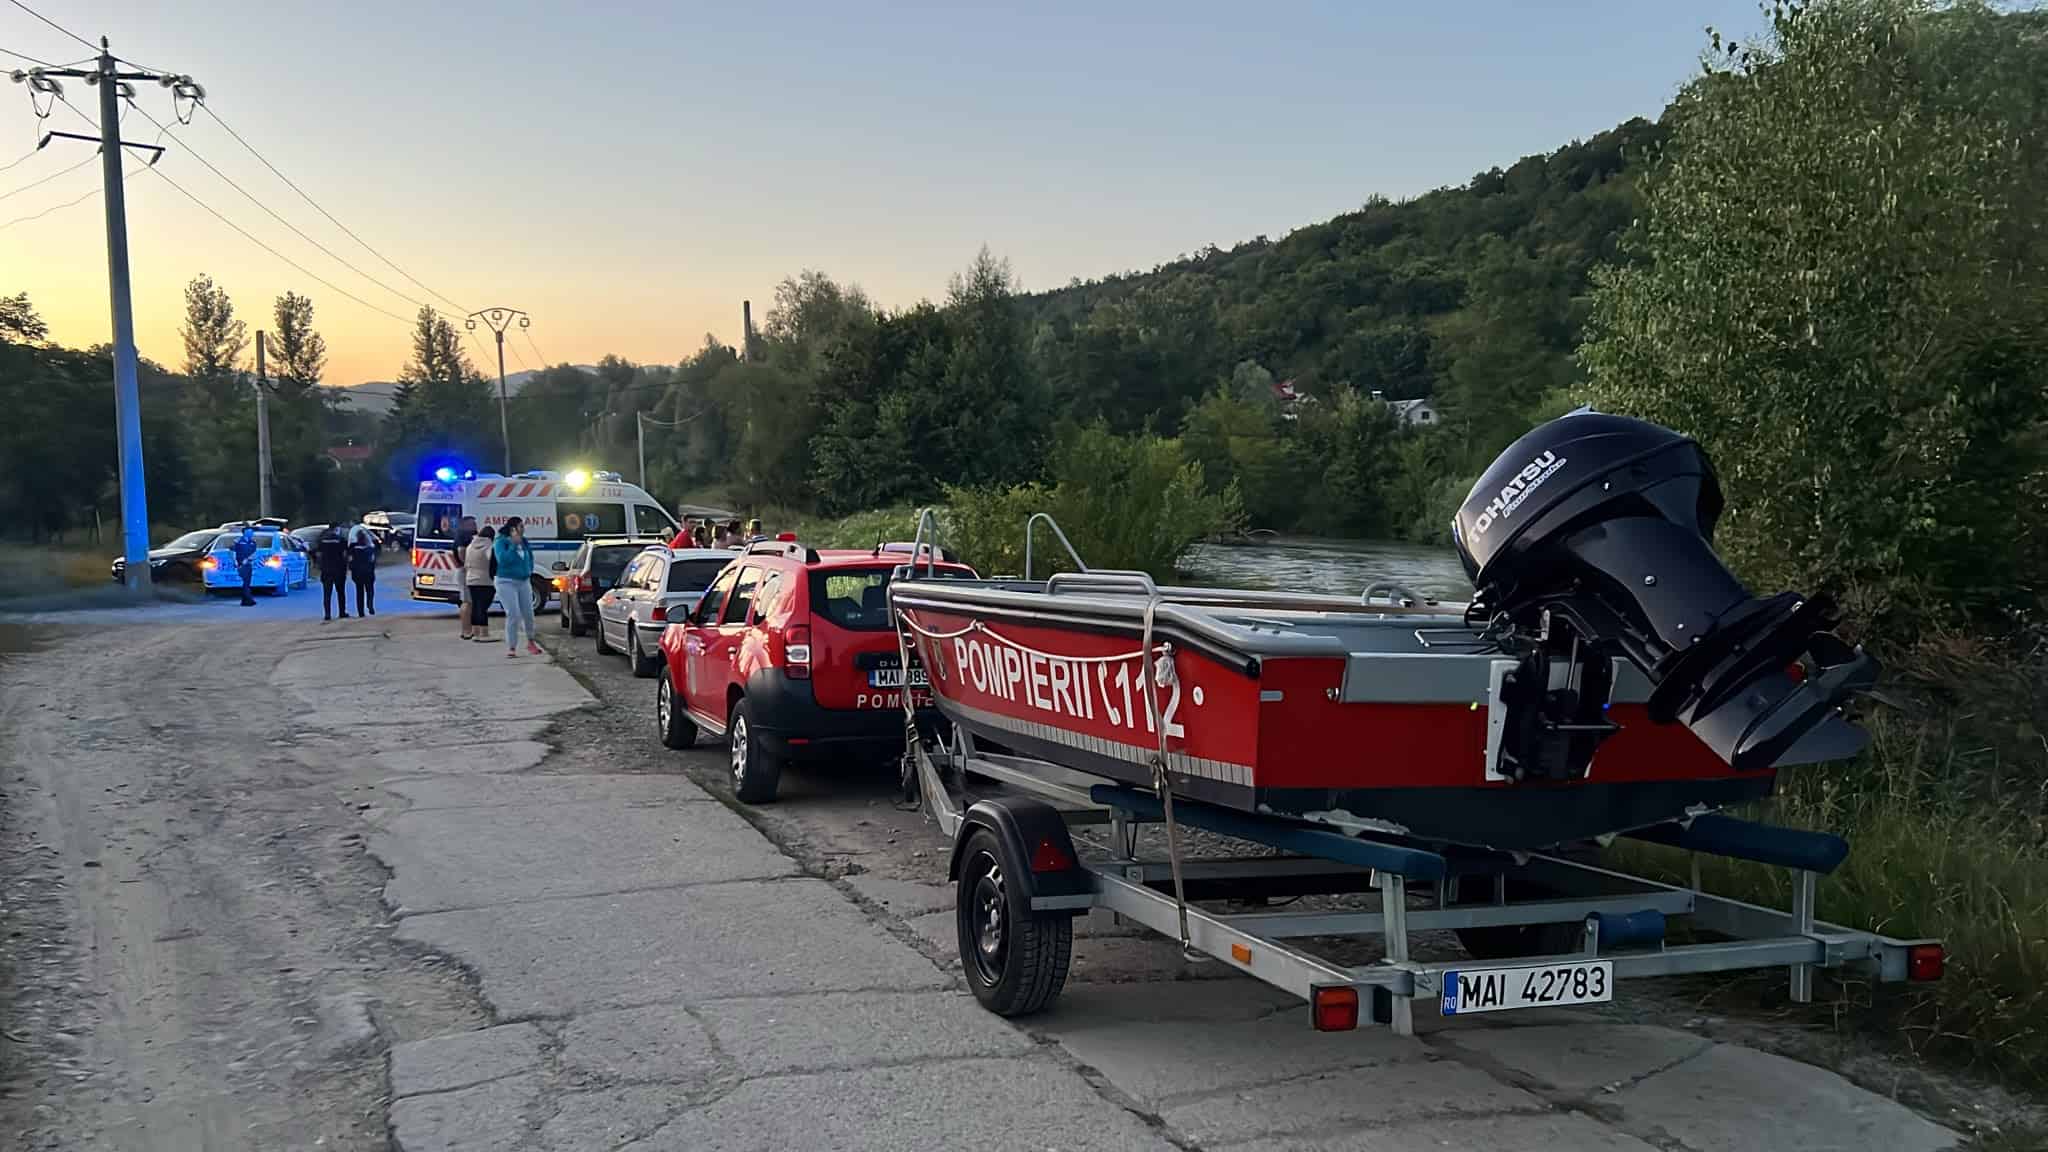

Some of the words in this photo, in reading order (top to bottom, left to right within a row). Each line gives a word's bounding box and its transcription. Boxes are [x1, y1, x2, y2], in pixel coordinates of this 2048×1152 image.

[1469, 450, 1556, 543] TOHATSU
[879, 669, 901, 685] MAI
[954, 637, 1094, 720] POMPIERII
[1115, 654, 1184, 739] 112
[1444, 997, 1457, 1010] RO
[1462, 974, 1506, 1008] MAI
[1521, 966, 1605, 1003] 42783
